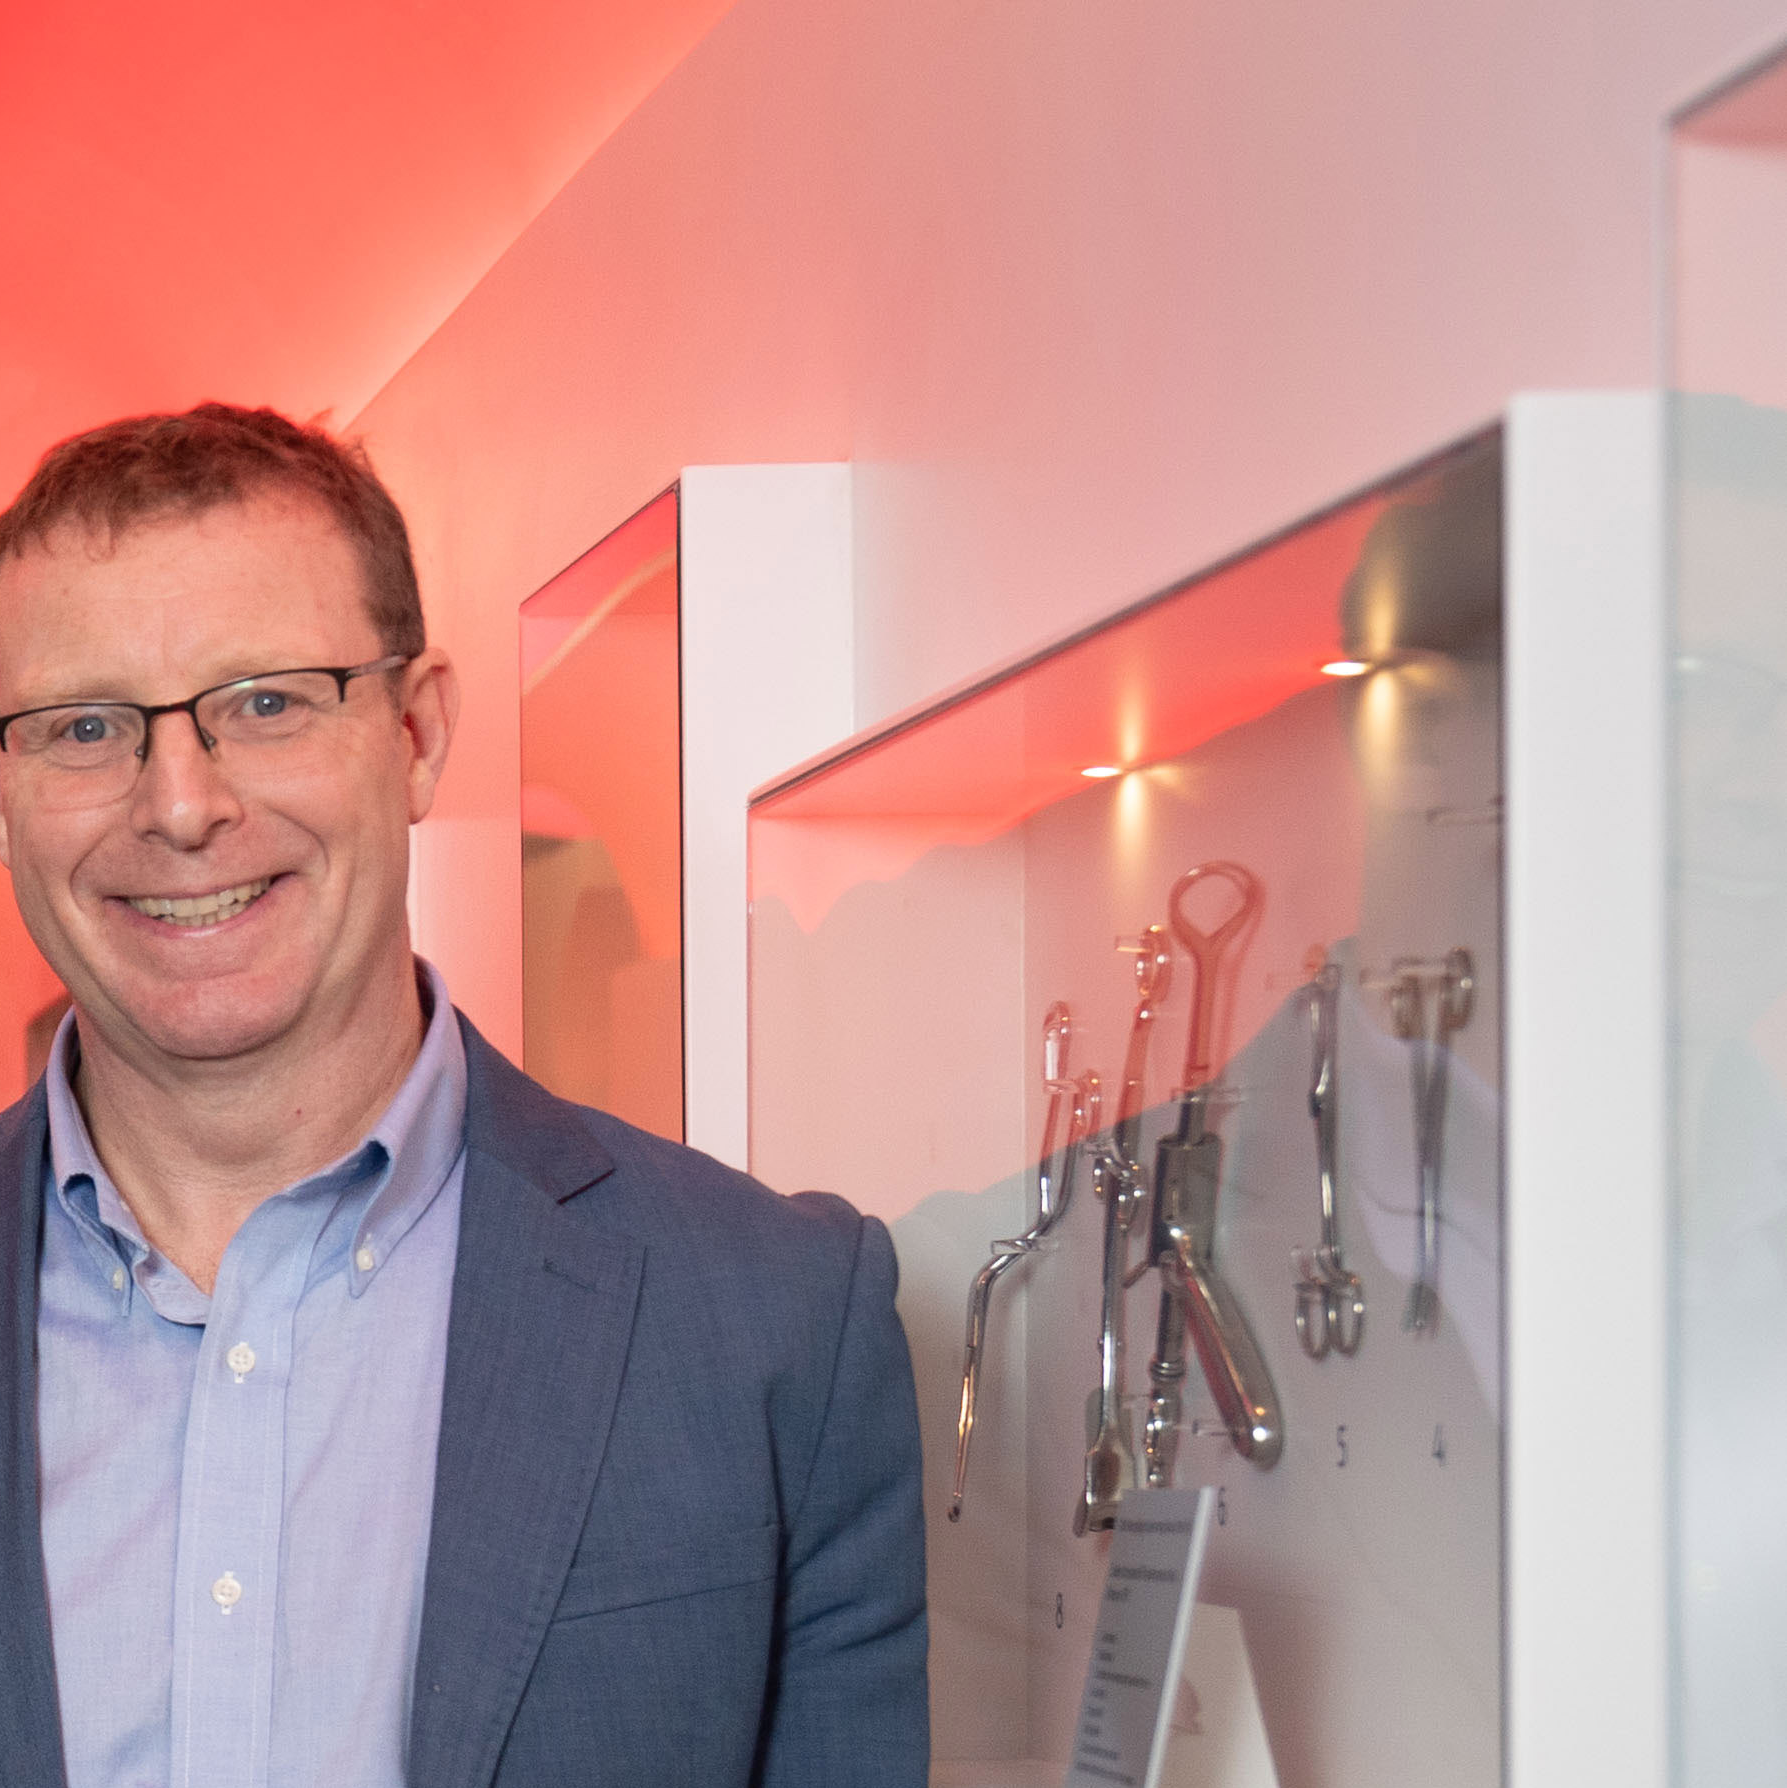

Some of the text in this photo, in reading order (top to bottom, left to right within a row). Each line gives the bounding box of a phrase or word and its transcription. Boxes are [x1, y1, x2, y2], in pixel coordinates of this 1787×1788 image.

[1337, 1424, 1347, 1468] 5
[1431, 1423, 1447, 1467] 4
[1216, 1485, 1226, 1527] 6
[1055, 1591, 1064, 1630] 8
